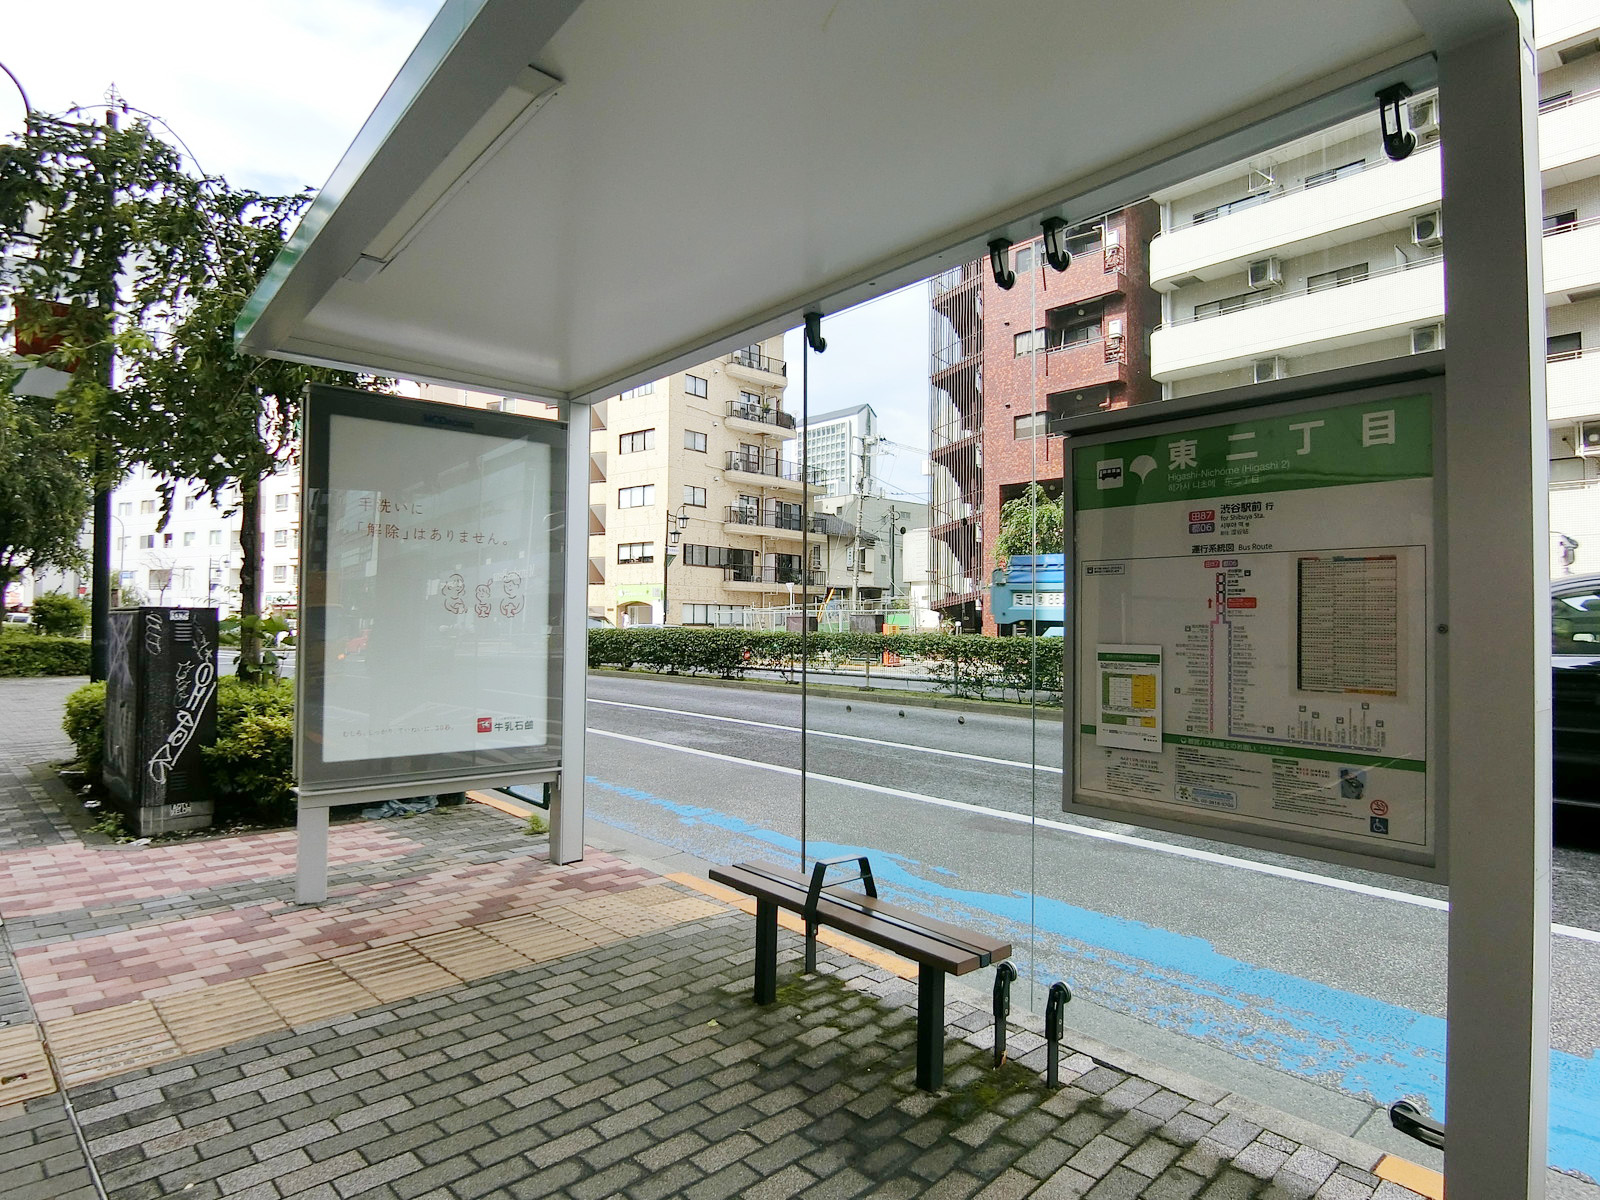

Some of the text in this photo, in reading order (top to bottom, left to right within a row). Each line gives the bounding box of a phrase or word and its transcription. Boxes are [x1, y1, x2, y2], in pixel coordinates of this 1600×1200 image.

[1167, 409, 1396, 471] 東二丁目
[1167, 459, 1290, 483] Higashi-Nichome (Higashi 2)
[359, 497, 424, 515] 手洗いに
[1220, 501, 1275, 514] 渋谷駅前 行
[358, 521, 508, 546] 「解除」はありません。
[1238, 543, 1251, 551] Bus
[1252, 542, 1273, 550] Route
